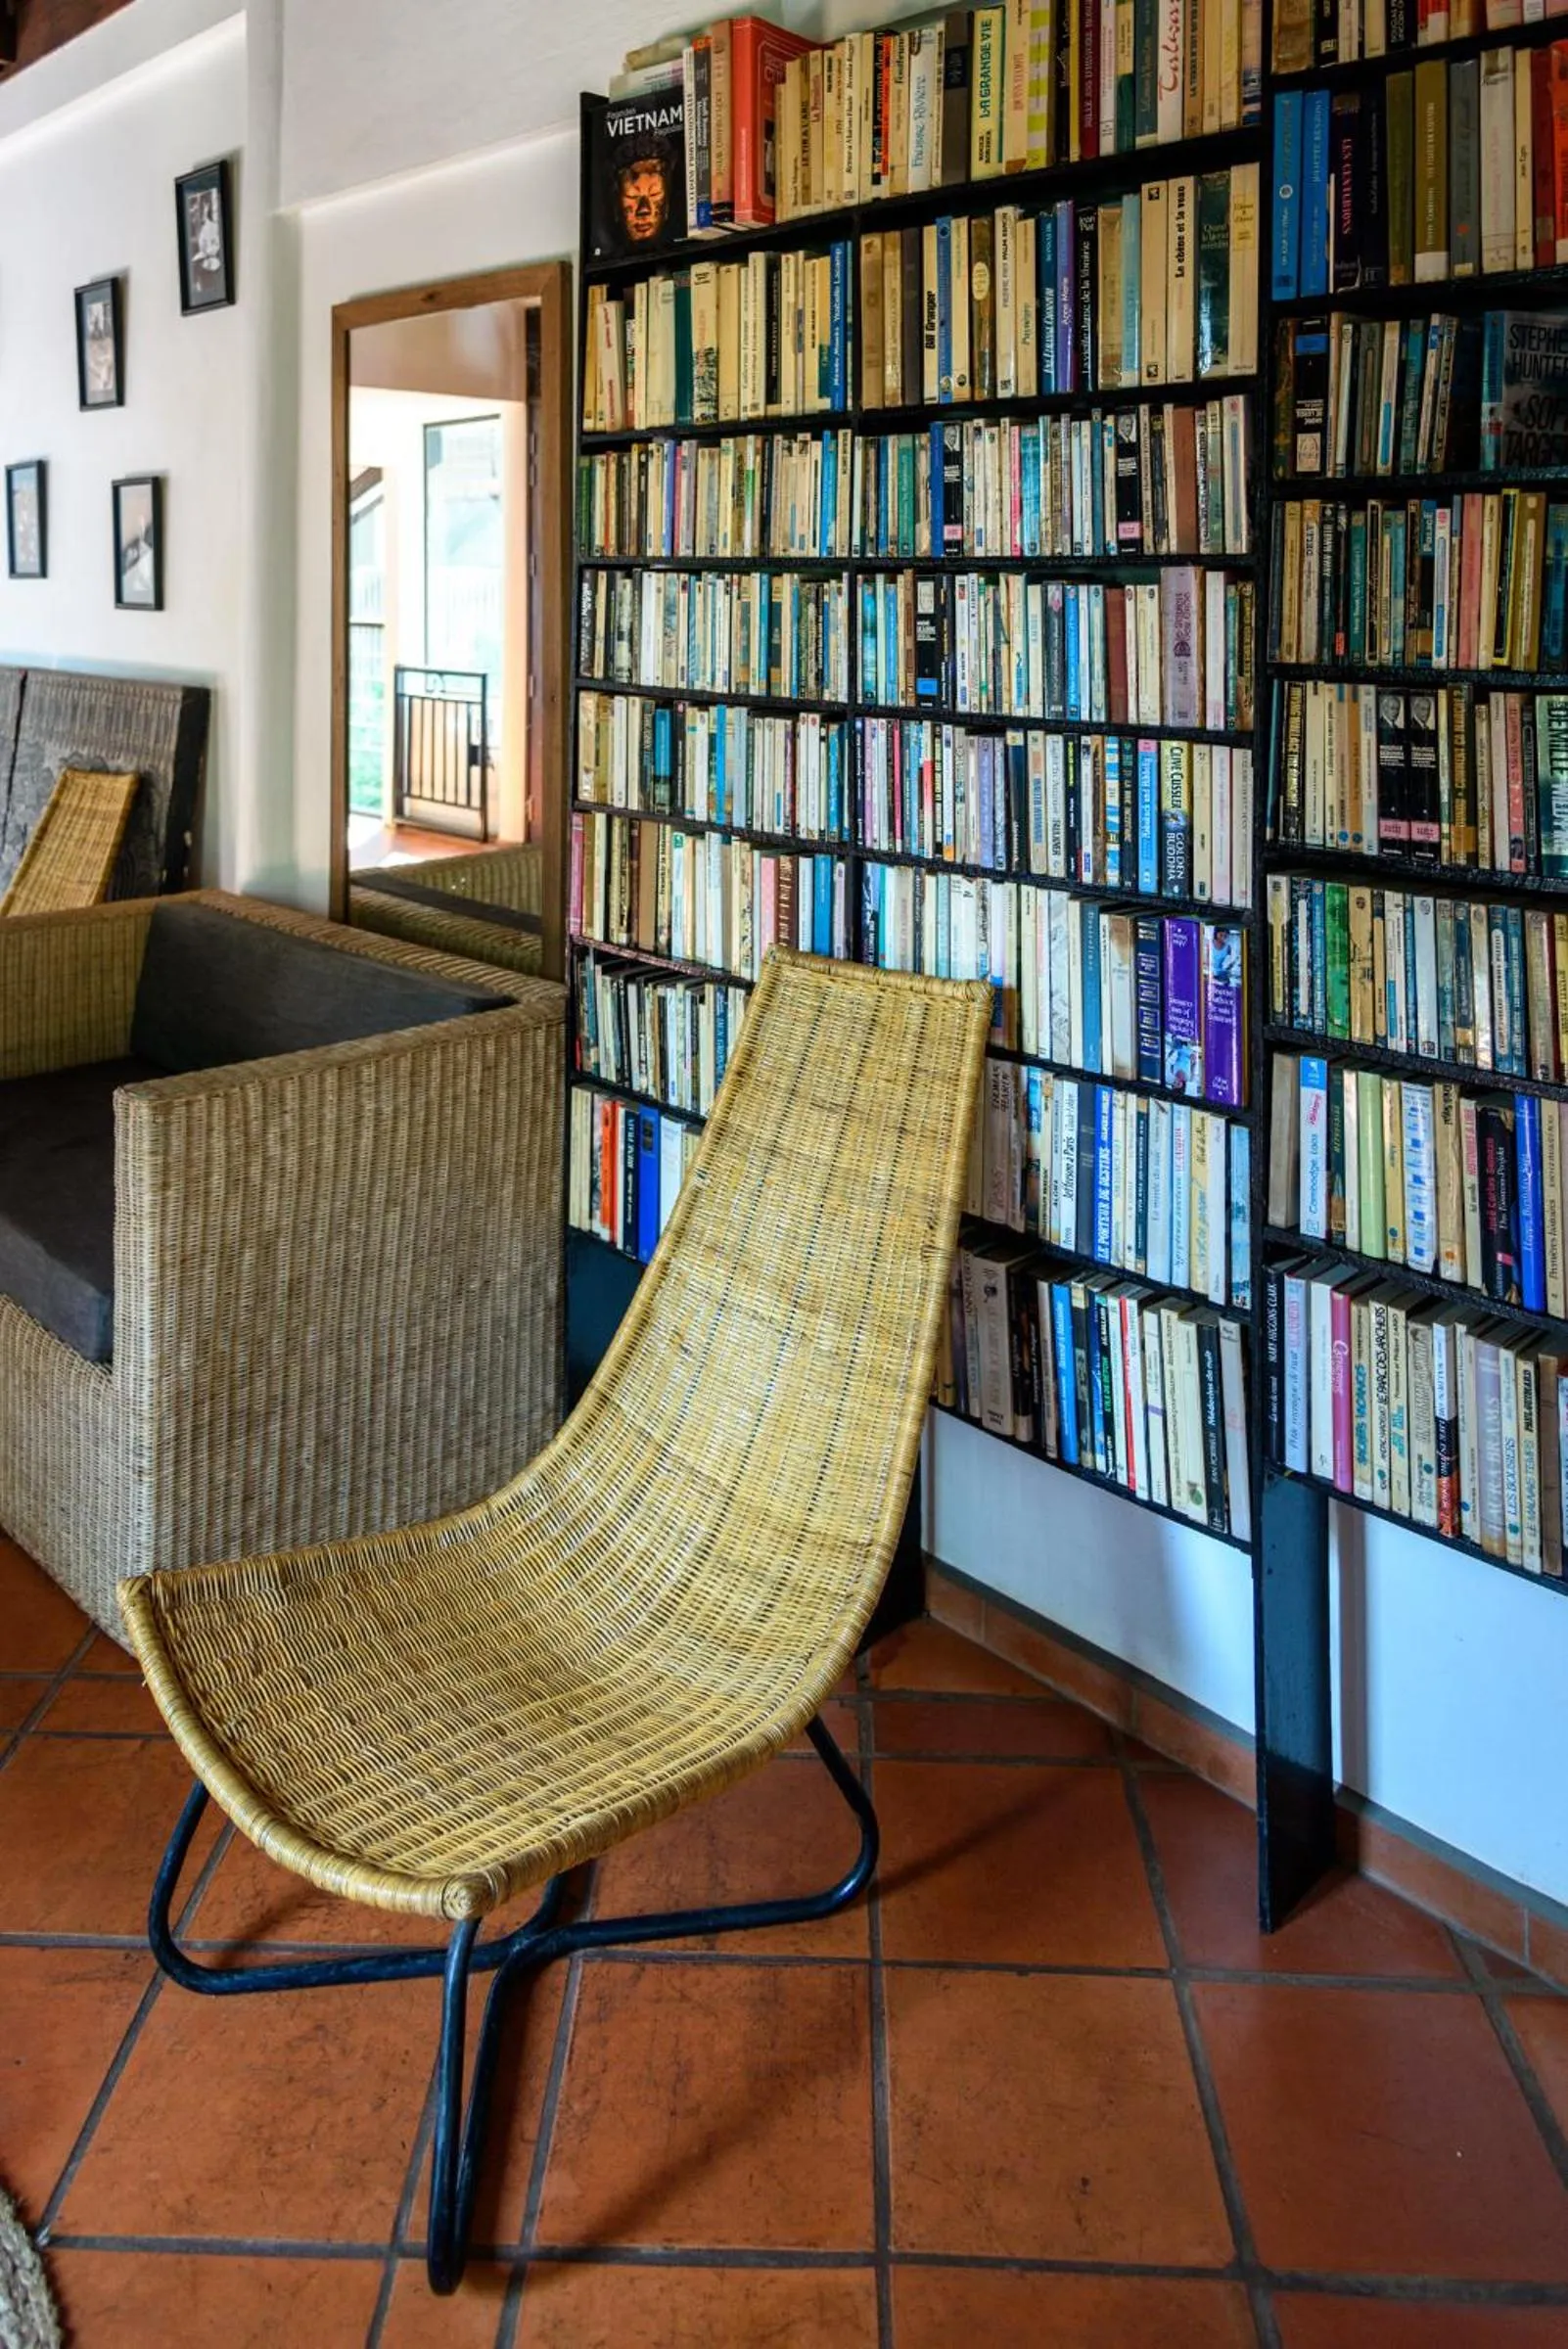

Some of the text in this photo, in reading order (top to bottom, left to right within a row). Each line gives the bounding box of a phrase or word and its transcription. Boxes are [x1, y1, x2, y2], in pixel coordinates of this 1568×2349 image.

[979, 19, 992, 118] LA GRANDE VIE
[607, 105, 683, 137] VIETNAM
[911, 124, 926, 167] Fausse
[1175, 209, 1184, 220] le
[1081, 280, 1090, 289] la
[1175, 266, 1184, 278] Le
[1081, 292, 1090, 302] de
[925, 291, 936, 348] Bill Granger
[1171, 747, 1183, 808] CLIVE CUSSLER
[1167, 832, 1176, 881] BUDDHA
[1063, 1137, 1075, 1156] Paris
[1310, 1133, 1318, 1155] Laos
[1063, 1163, 1075, 1201] Jefferson
[1487, 1177, 1496, 1208] Carlos
[1098, 1147, 1110, 1259] LE PORTEUR DE DESTINS
[1268, 1308, 1277, 1341] HIGGINS
[1374, 1307, 1387, 1405] LE PARC DES ARCHERS
[1206, 1368, 1214, 1380] de
[1206, 1382, 1216, 1425] Médecins
[1524, 1411, 1533, 1433] PAUL
[1483, 1396, 1501, 1534] LAURA BRAMS
[1507, 1494, 1517, 1517] LES
[1527, 1524, 1537, 1537] LE
